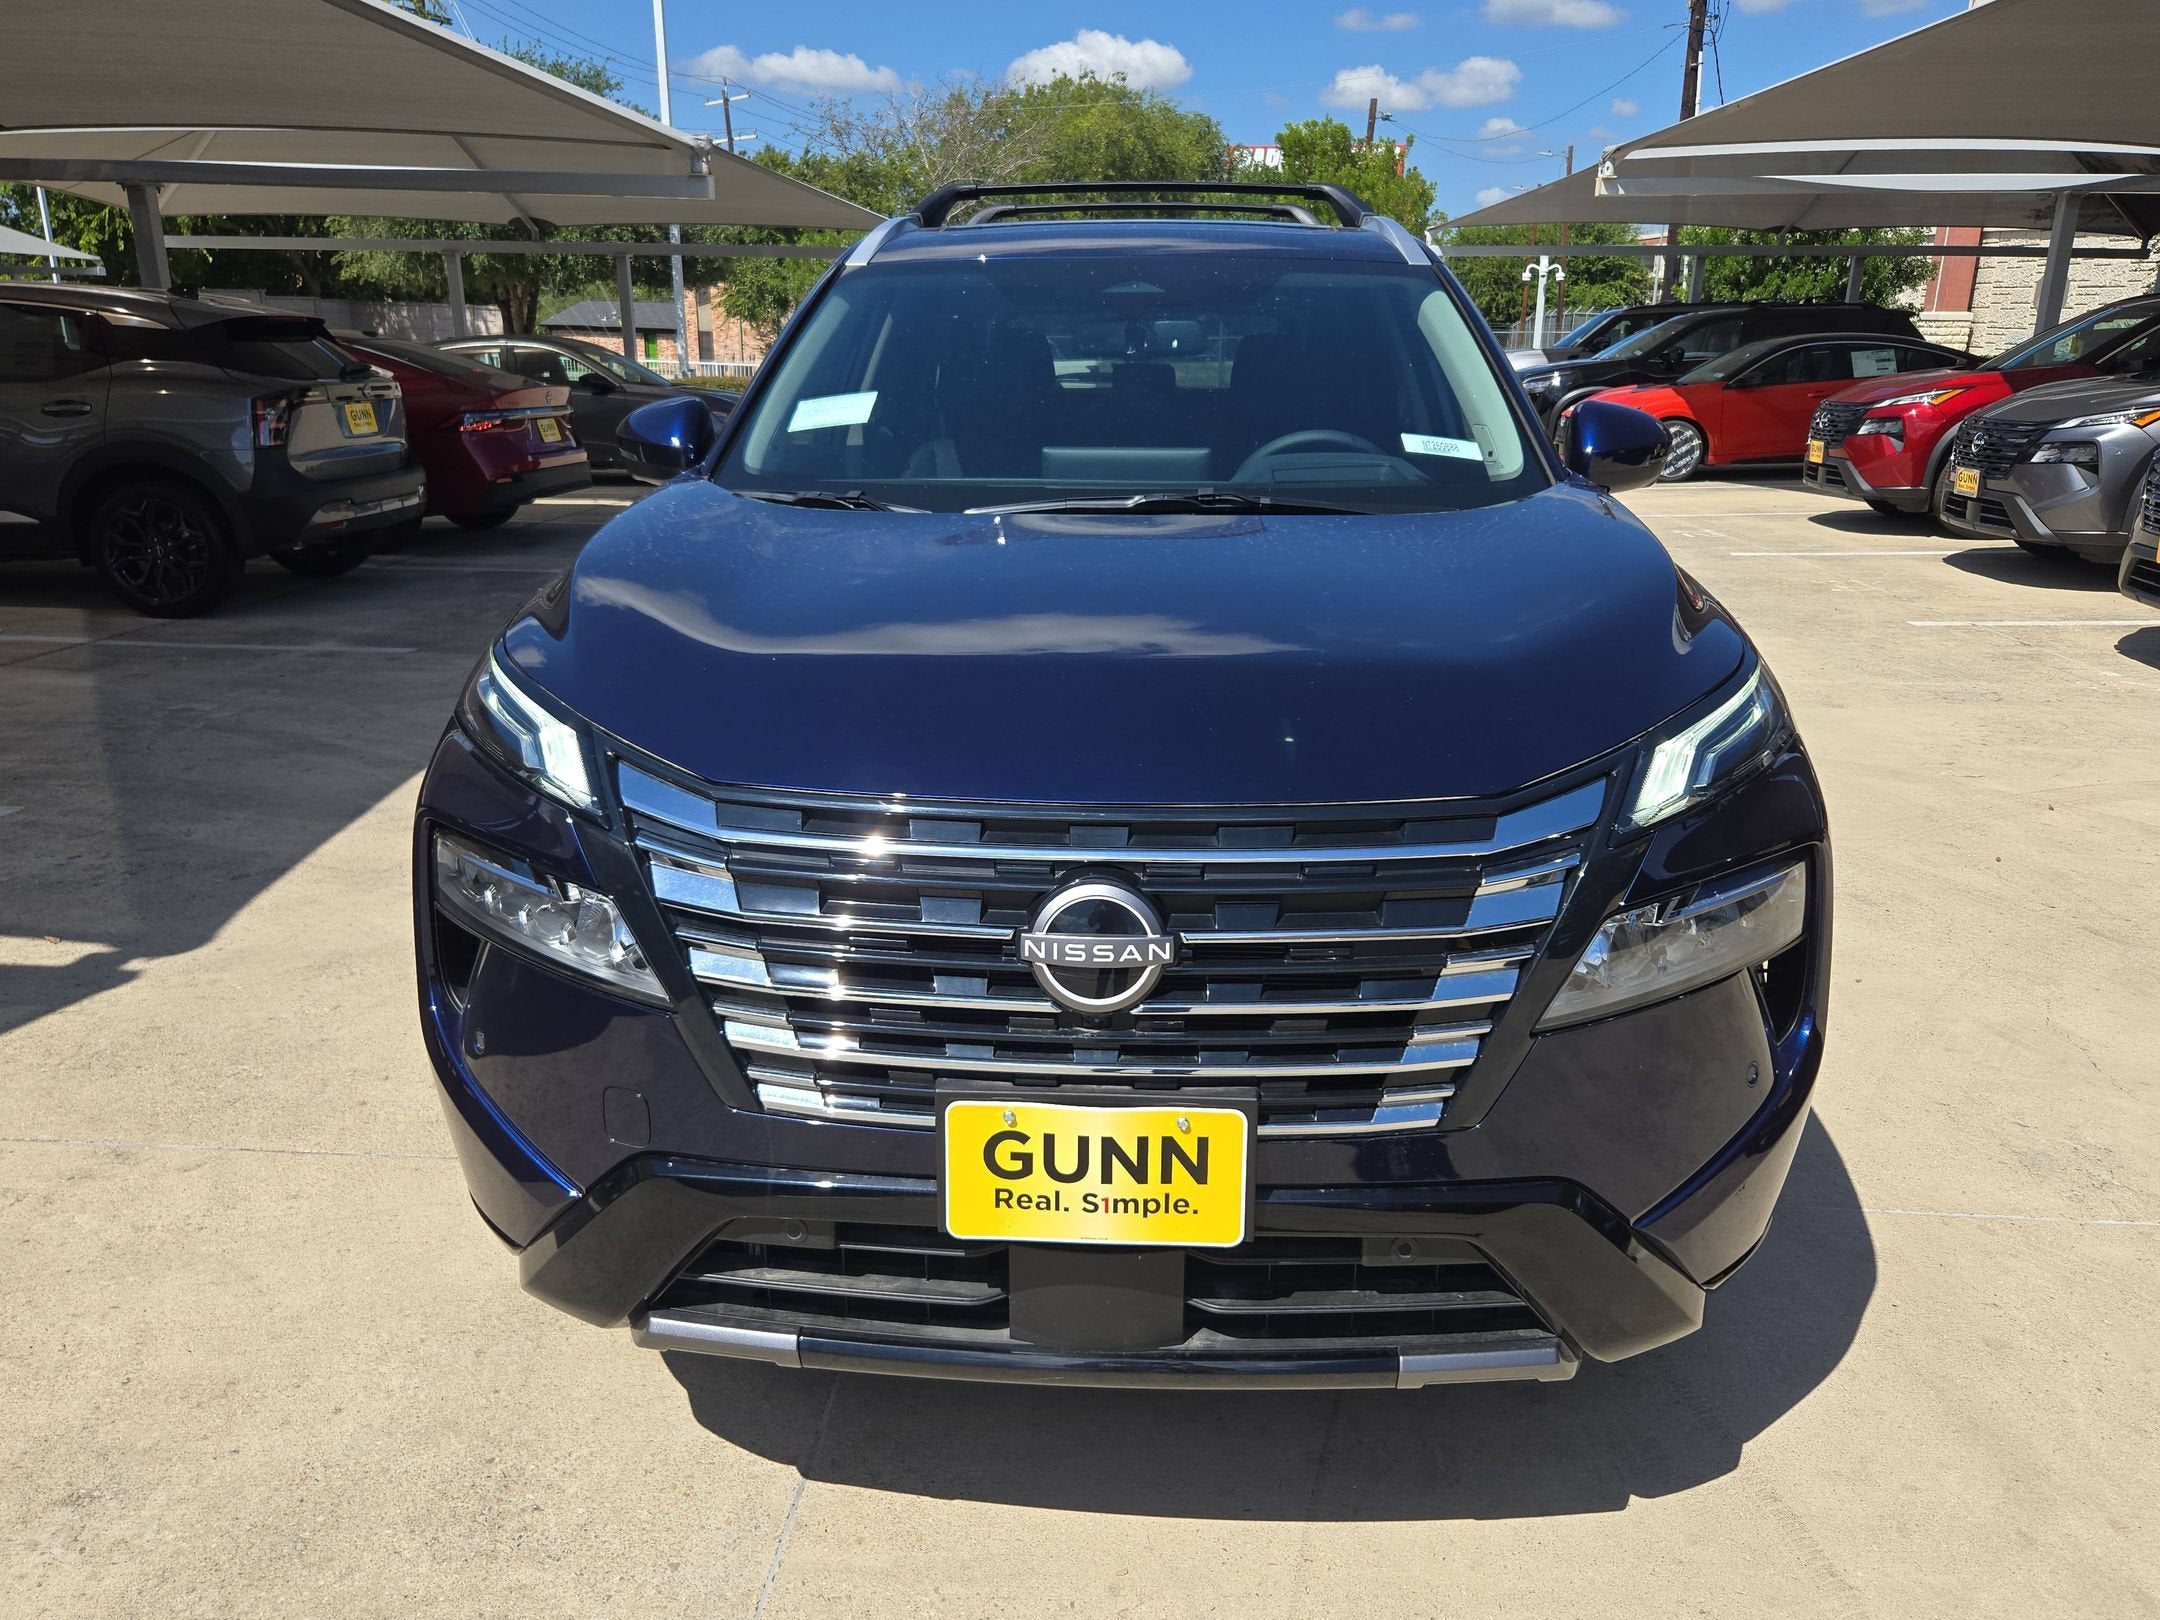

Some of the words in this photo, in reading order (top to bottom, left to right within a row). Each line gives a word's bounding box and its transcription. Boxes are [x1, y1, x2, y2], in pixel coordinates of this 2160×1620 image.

[350, 408, 372, 421] GUNN
[1958, 471, 1978, 486] GUNN
[1024, 939, 1170, 963] NISSAN
[982, 1129, 1209, 1185] GUNN
[994, 1187, 1070, 1212] Real.
